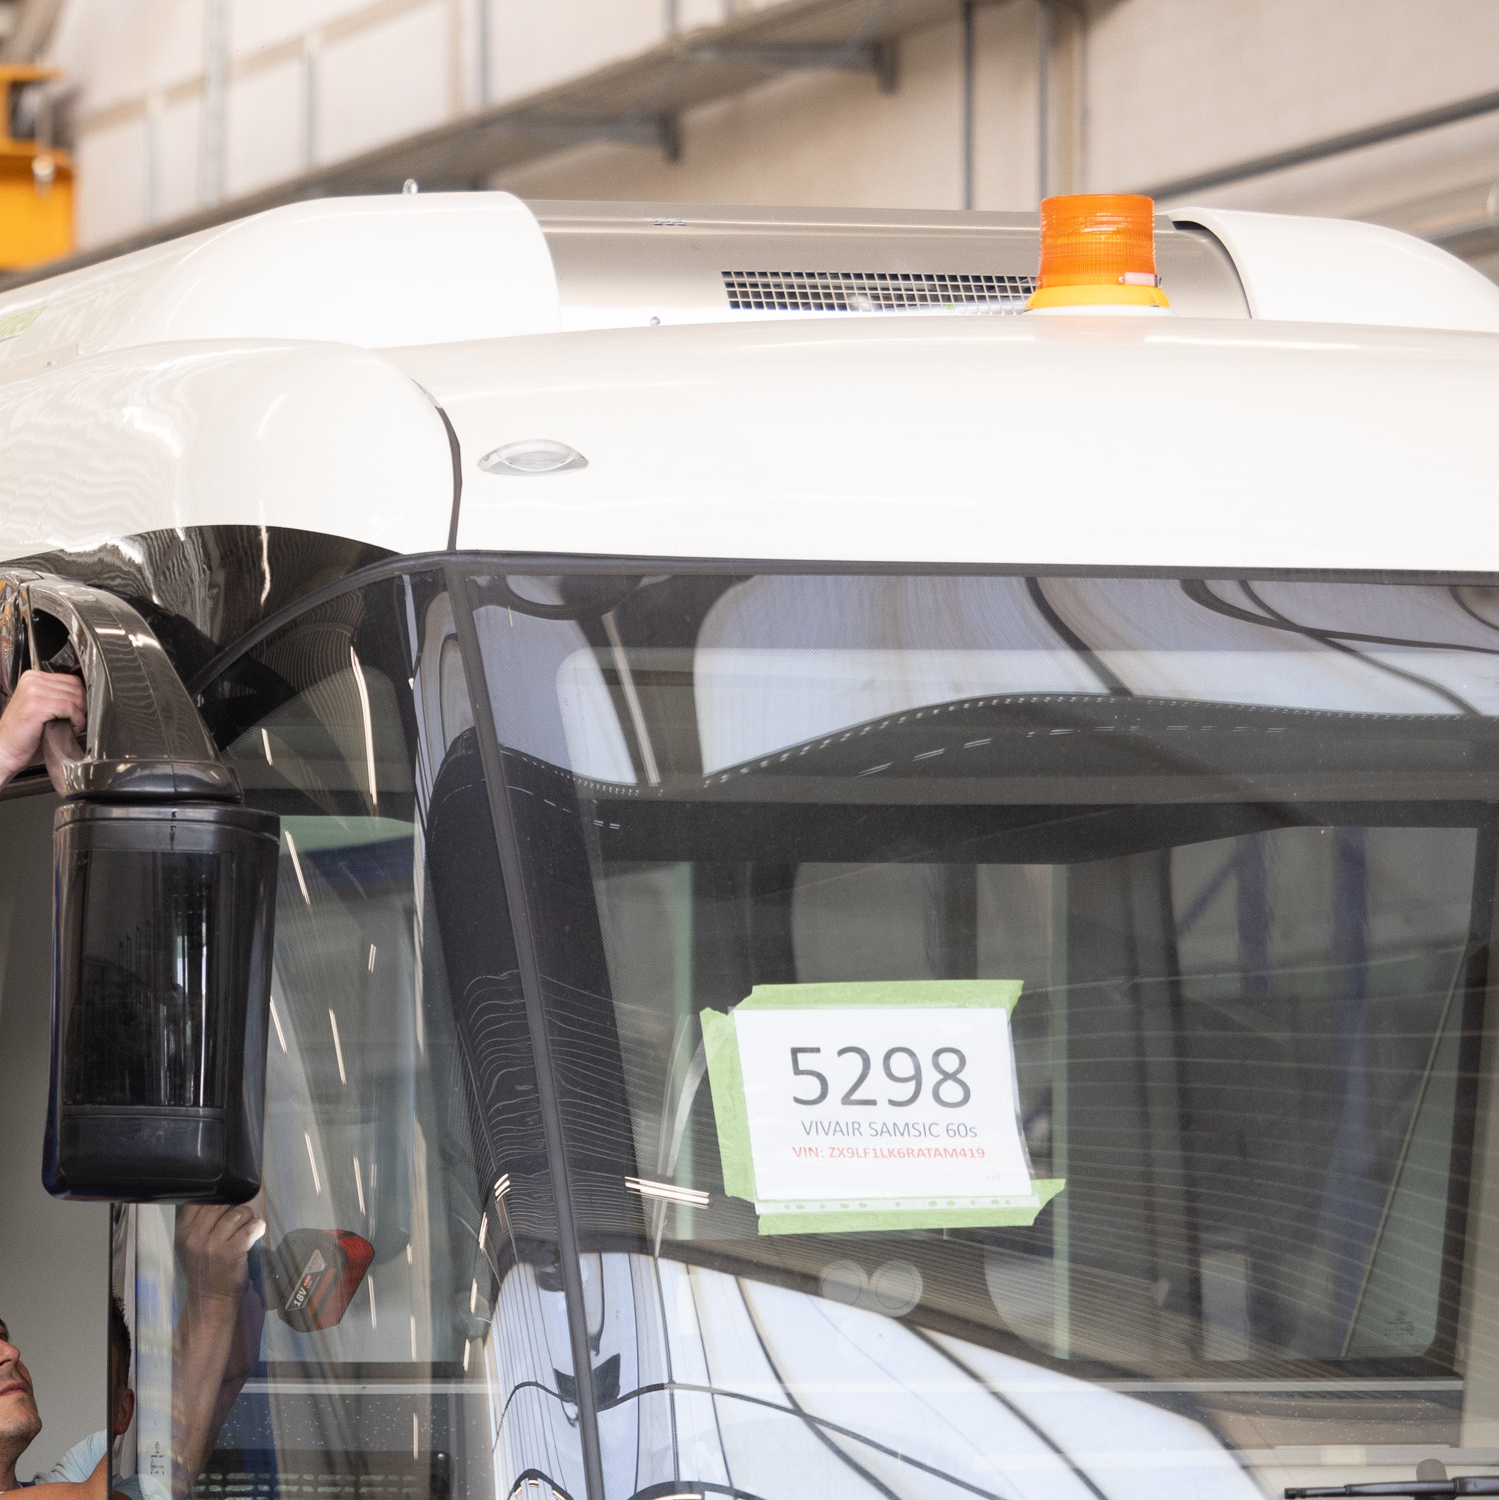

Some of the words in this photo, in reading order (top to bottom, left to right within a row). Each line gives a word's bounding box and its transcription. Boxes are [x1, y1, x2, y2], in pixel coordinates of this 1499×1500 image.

[789, 1045, 972, 1109] 5298
[800, 1120, 863, 1137] VIVAIR
[868, 1121, 941, 1138] SAMSIC
[945, 1122, 978, 1139] 60s
[792, 1146, 825, 1159] VIN:
[827, 1146, 986, 1159] ZX9LF1LK6RATAM419
[293, 1287, 307, 1307] 18V
